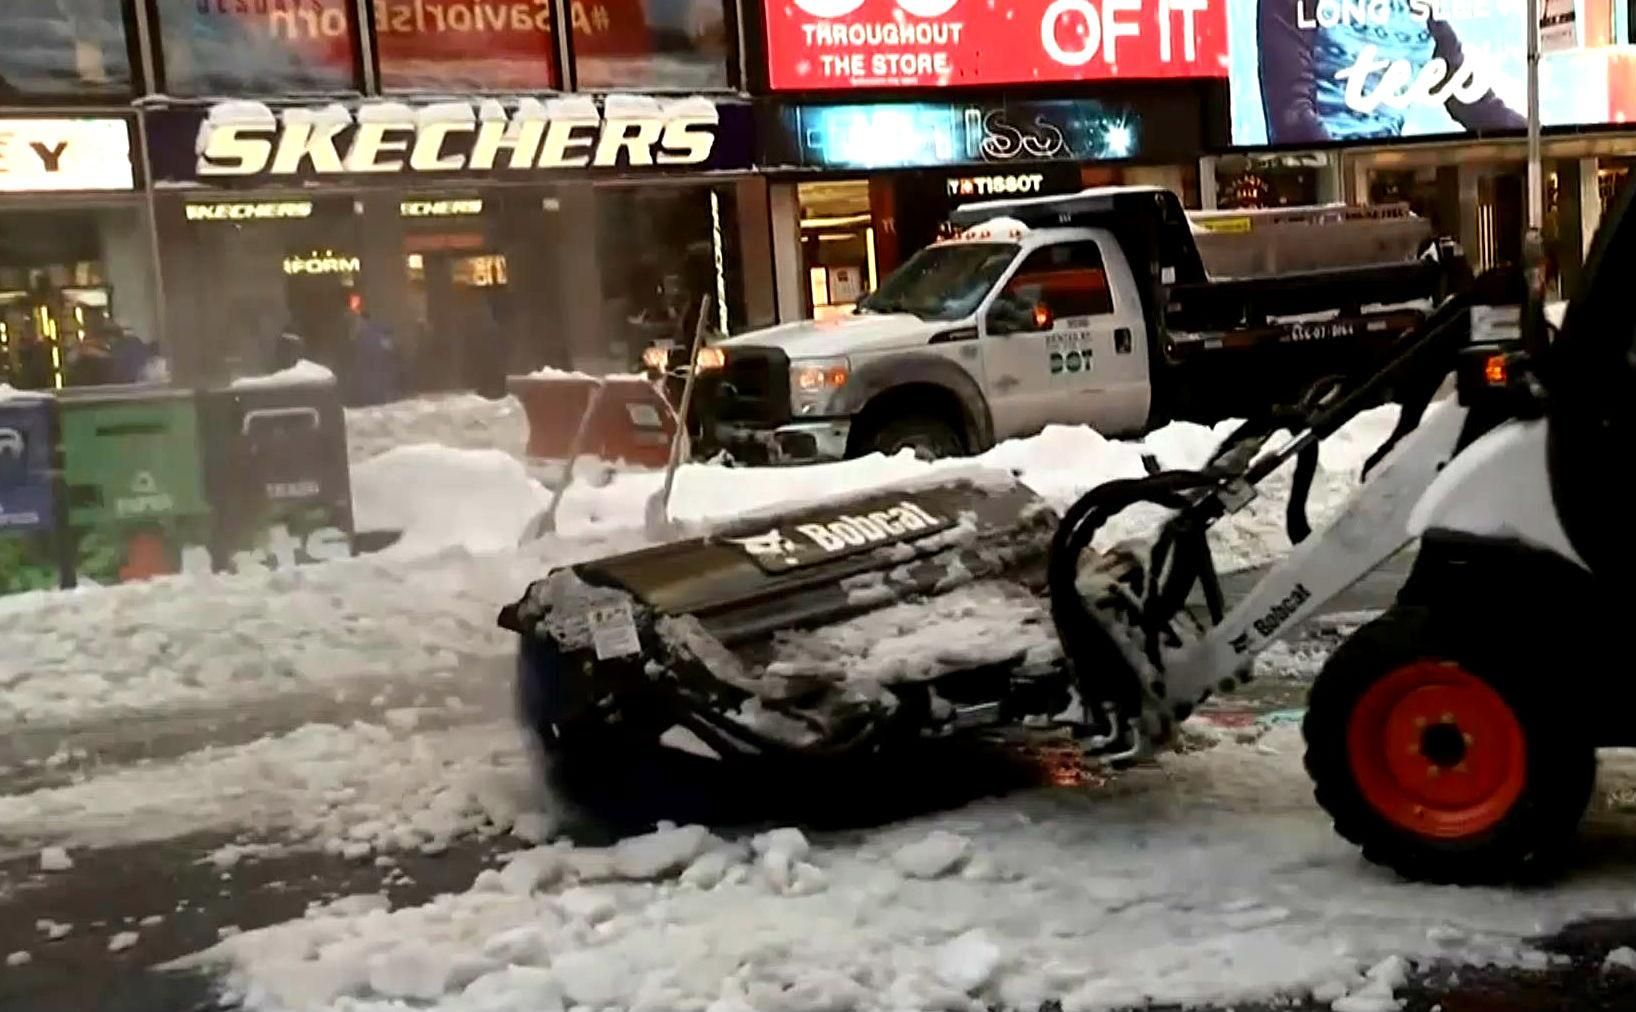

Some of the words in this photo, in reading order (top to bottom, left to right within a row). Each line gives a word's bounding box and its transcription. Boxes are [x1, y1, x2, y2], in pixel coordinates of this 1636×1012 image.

[801, 23, 963, 46] THROUGHOUT
[1041, 0, 1141, 66] OF
[1158, 0, 1207, 62] IT
[1296, 0, 1392, 30] LONG
[820, 55, 865, 76] THE
[872, 53, 950, 75] STORE
[1334, 45, 1494, 114] tees
[197, 112, 718, 174] SKECHERS
[1050, 349, 1093, 374] DOT
[796, 500, 940, 552] Bobcat
[1253, 583, 1312, 638] Bobcat
